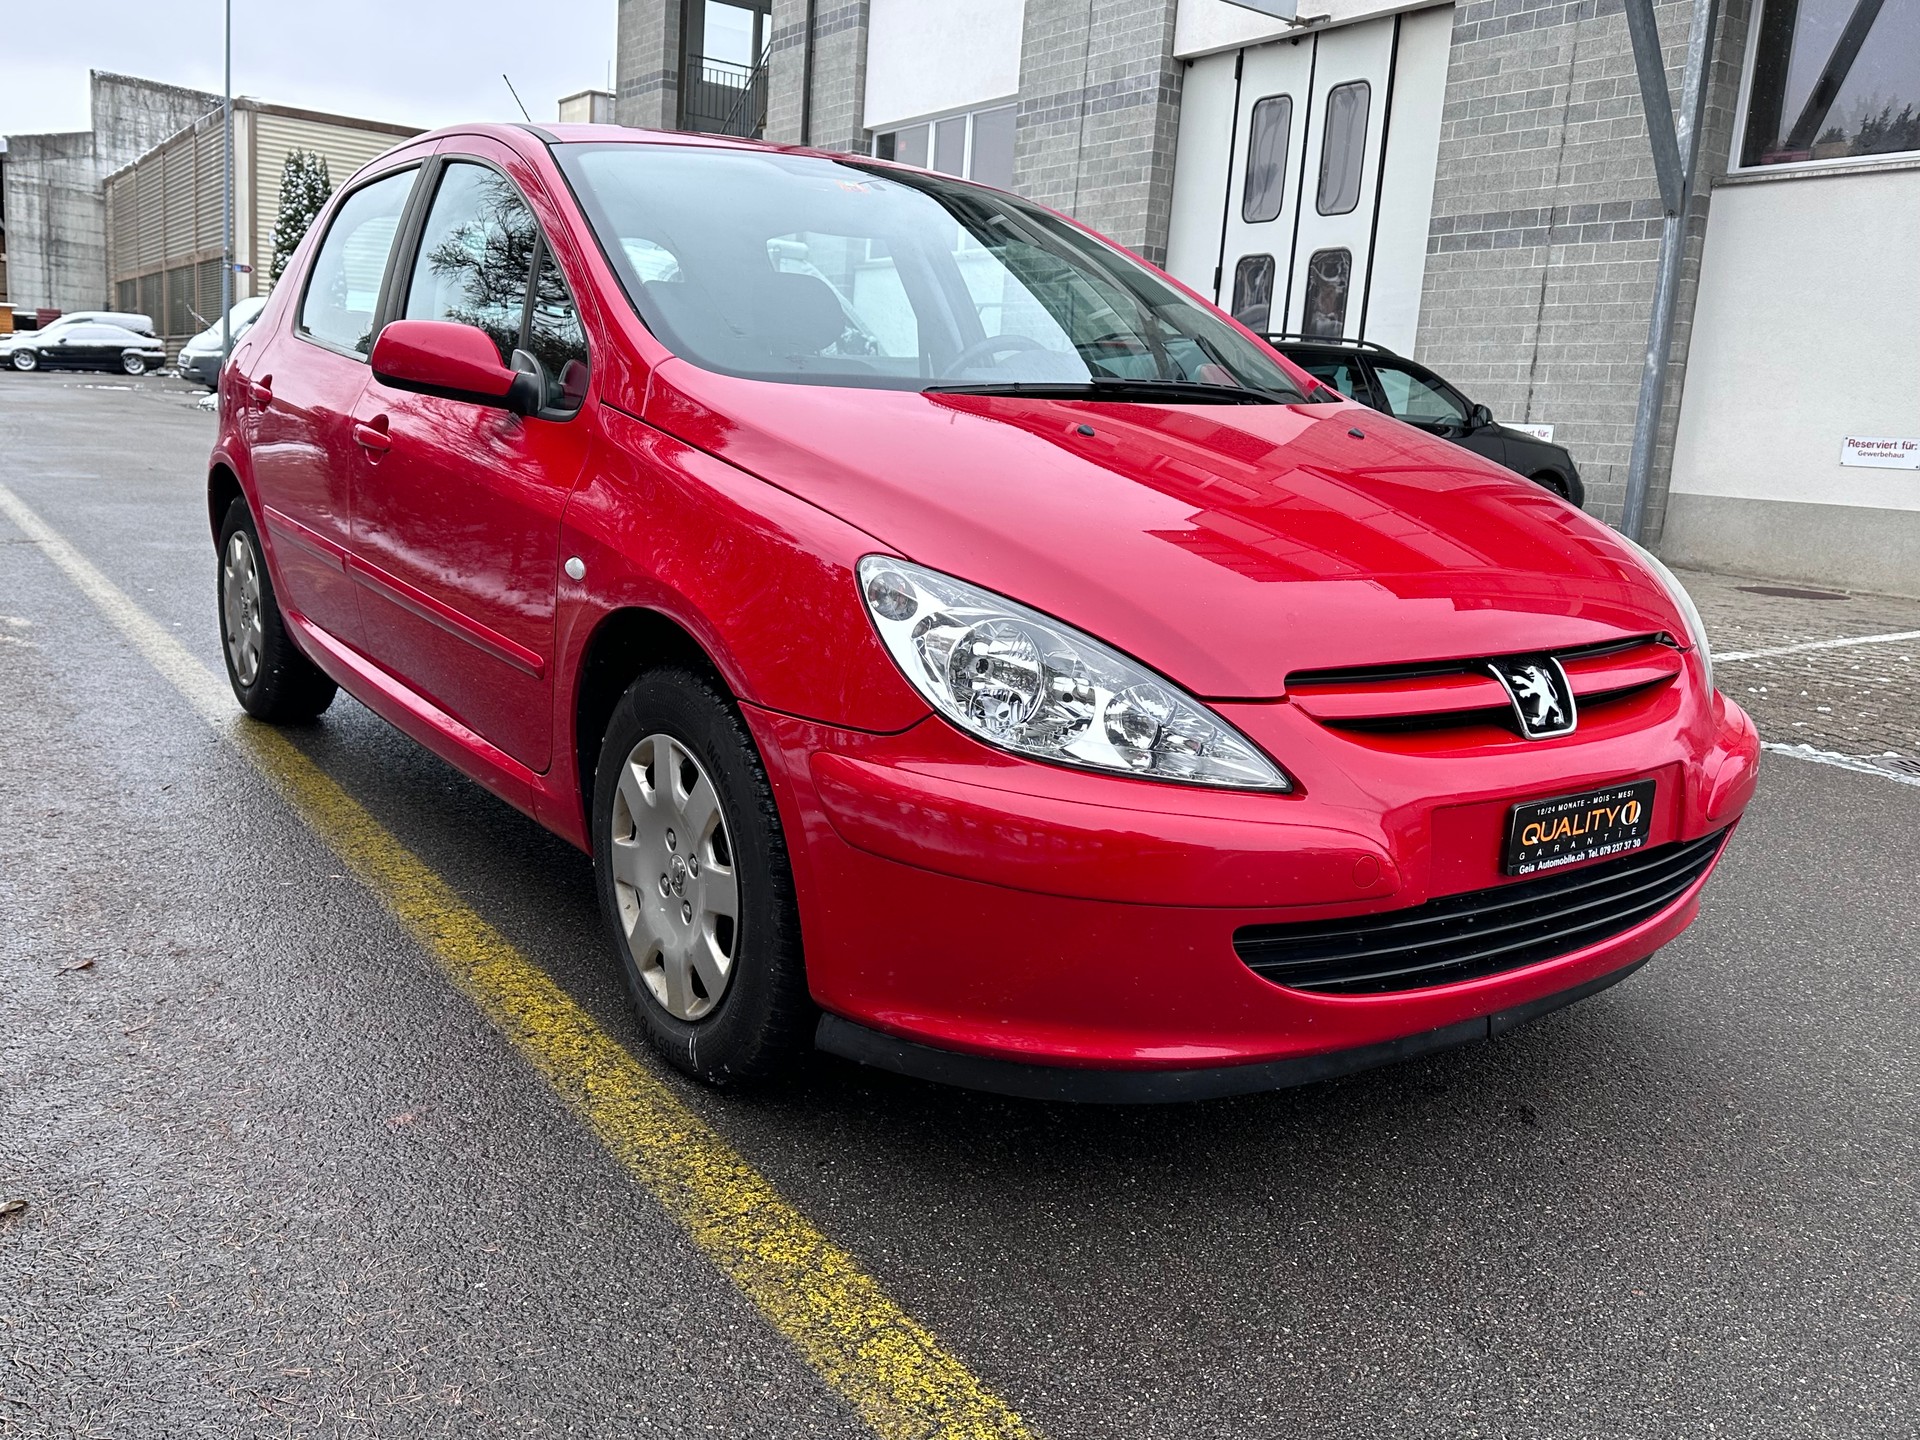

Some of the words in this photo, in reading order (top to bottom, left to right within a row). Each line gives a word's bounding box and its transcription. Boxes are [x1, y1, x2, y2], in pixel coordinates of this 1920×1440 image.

[1847, 438, 1898, 450] Reserviert
[1901, 440, 1918, 451] für:
[1857, 449, 1905, 459] Gewerbehaus
[1536, 805, 1556, 816] 12/24
[1558, 799, 1586, 812] MONATE
[1593, 794, 1610, 804] MOIS
[1617, 789, 1635, 799] MESI
[1521, 805, 1621, 846] QUALITY
[1537, 851, 1586, 871] Automobile.ch
[1599, 845, 1611, 856] 079
[1611, 841, 1623, 854] 237
[1623, 839, 1632, 850] 37
[1632, 838, 1641, 848] 30
[658, 1036, 692, 1065] 95/65
